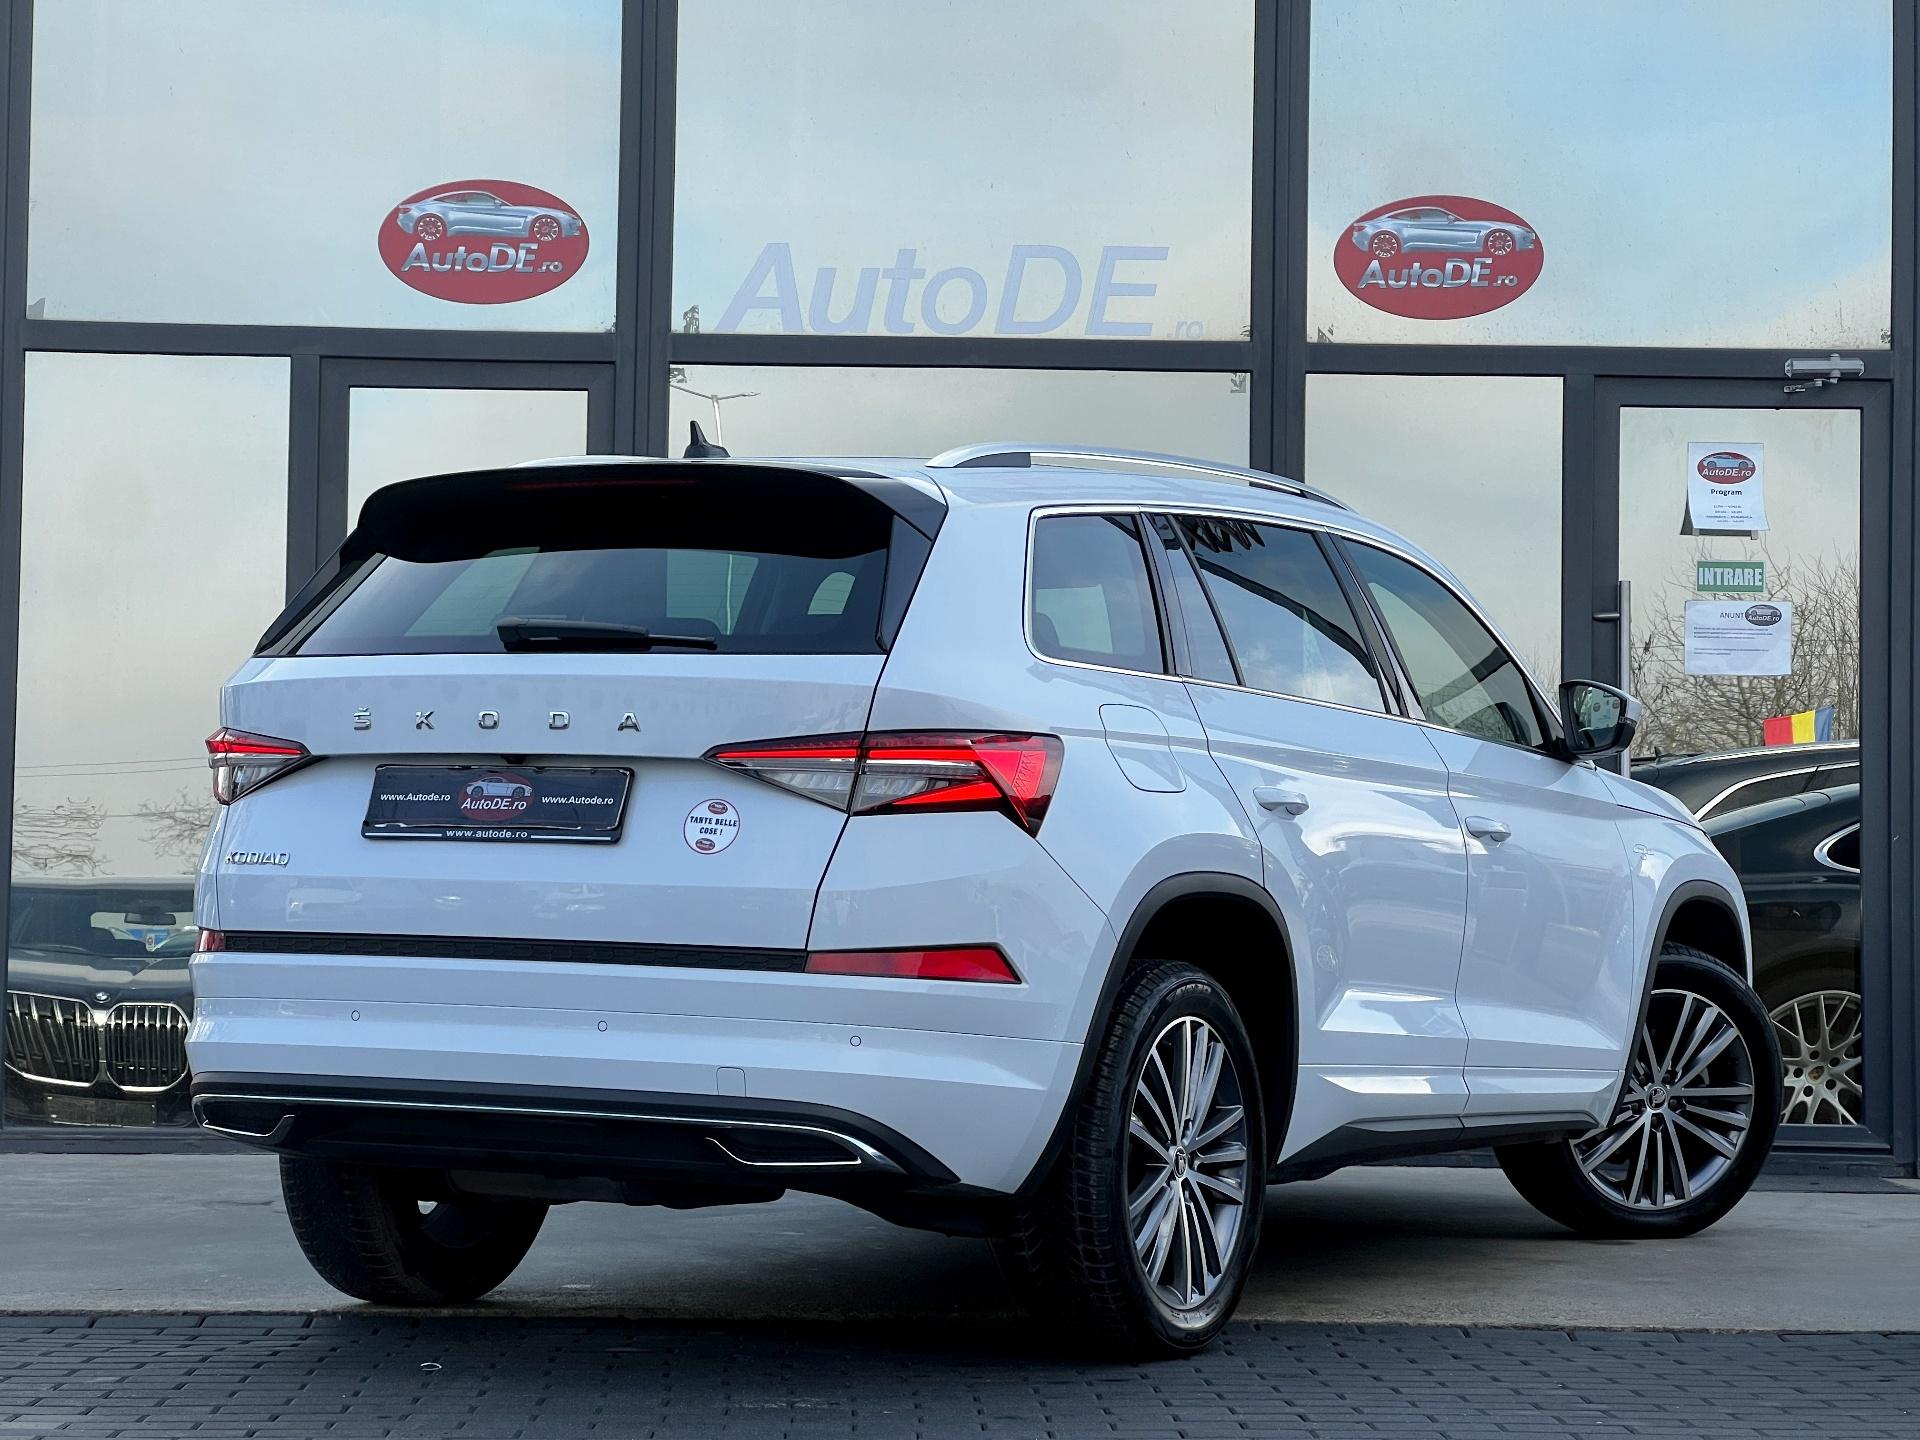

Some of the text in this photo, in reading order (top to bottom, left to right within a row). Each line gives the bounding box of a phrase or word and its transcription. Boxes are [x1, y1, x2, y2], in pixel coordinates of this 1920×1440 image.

[1702, 468, 1752, 477] AutoDE.ro
[1710, 488, 1743, 496] Program
[1698, 567, 1763, 586] INTRARE
[353, 707, 641, 732] ŠKODA
[380, 792, 451, 802] www.Autode.ro
[541, 795, 614, 805] www.Autode.ro
[460, 797, 527, 811] AutoDE.ro
[690, 816, 738, 827] TANTE BELLE
[446, 829, 528, 839] www.autode.ro
[699, 827, 718, 835] COSE
